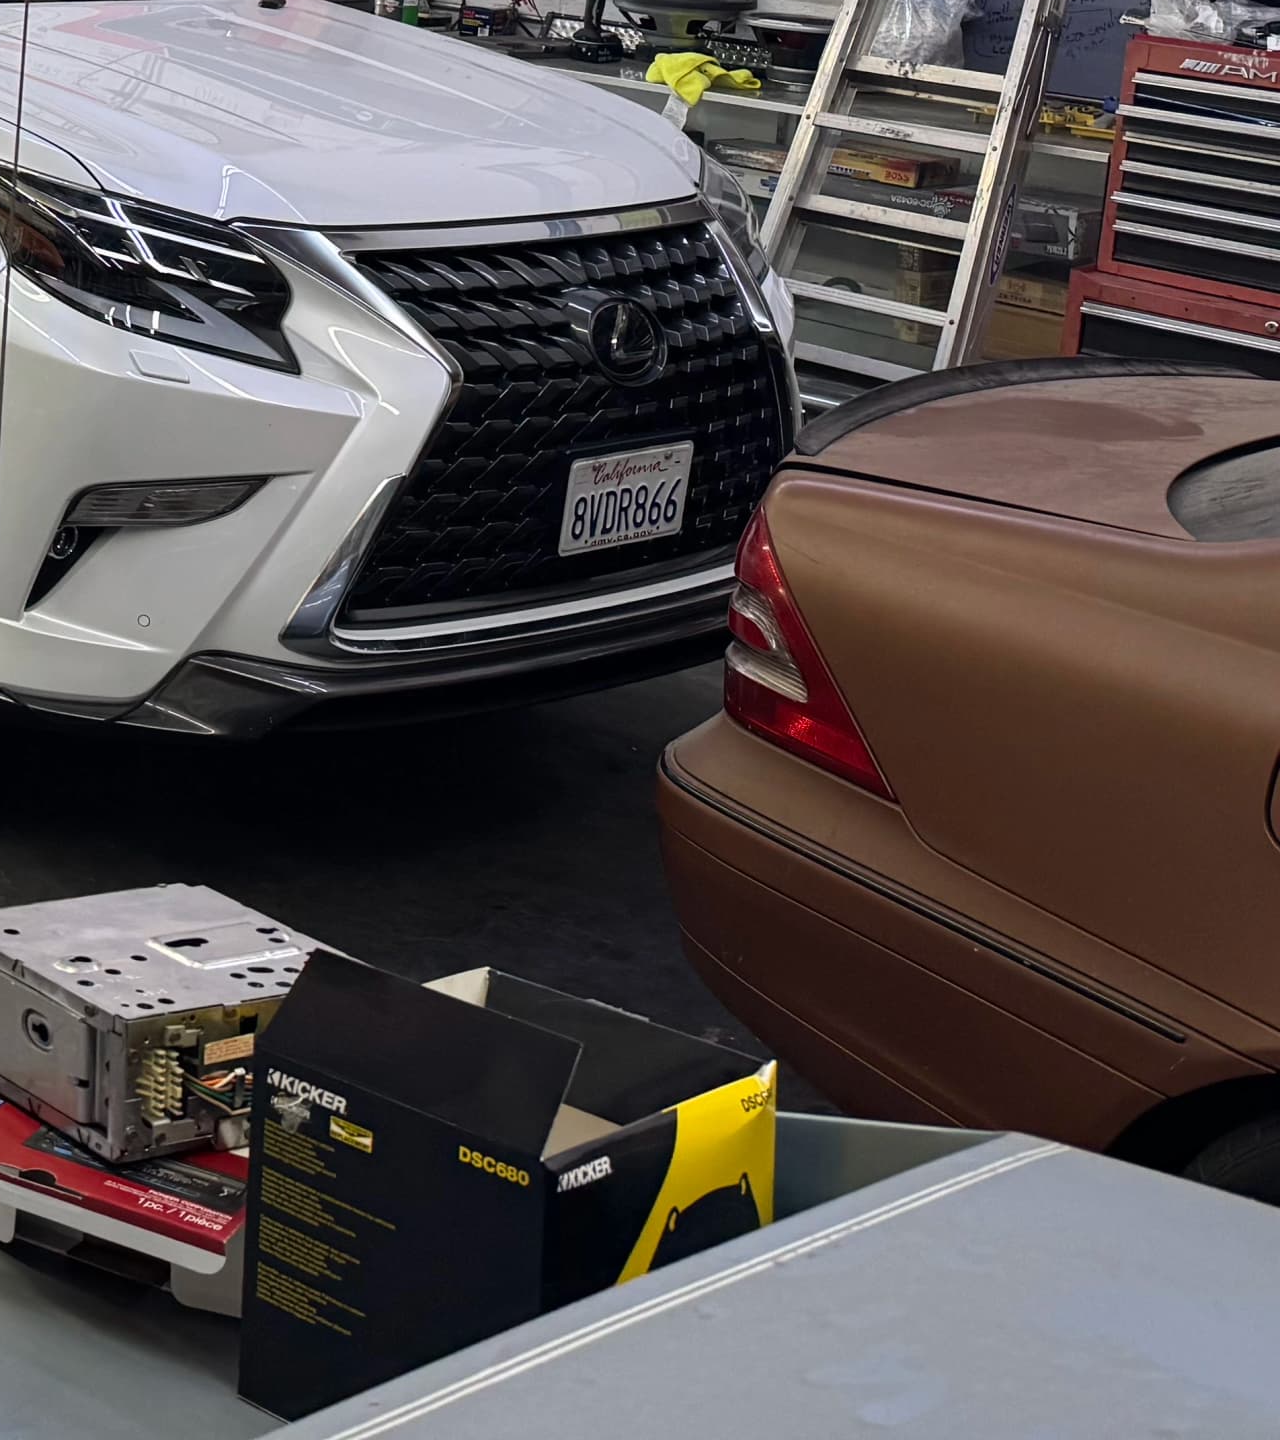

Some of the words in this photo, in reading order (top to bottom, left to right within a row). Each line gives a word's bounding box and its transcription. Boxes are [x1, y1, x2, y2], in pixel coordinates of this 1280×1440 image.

[592, 458, 669, 487] California
[571, 478, 683, 541] 8VDR866
[590, 528, 654, 547] dmv.ca.gov
[280, 1073, 347, 1115] KICKER
[458, 1145, 531, 1186] DSC680
[567, 1155, 612, 1191] KICKER
